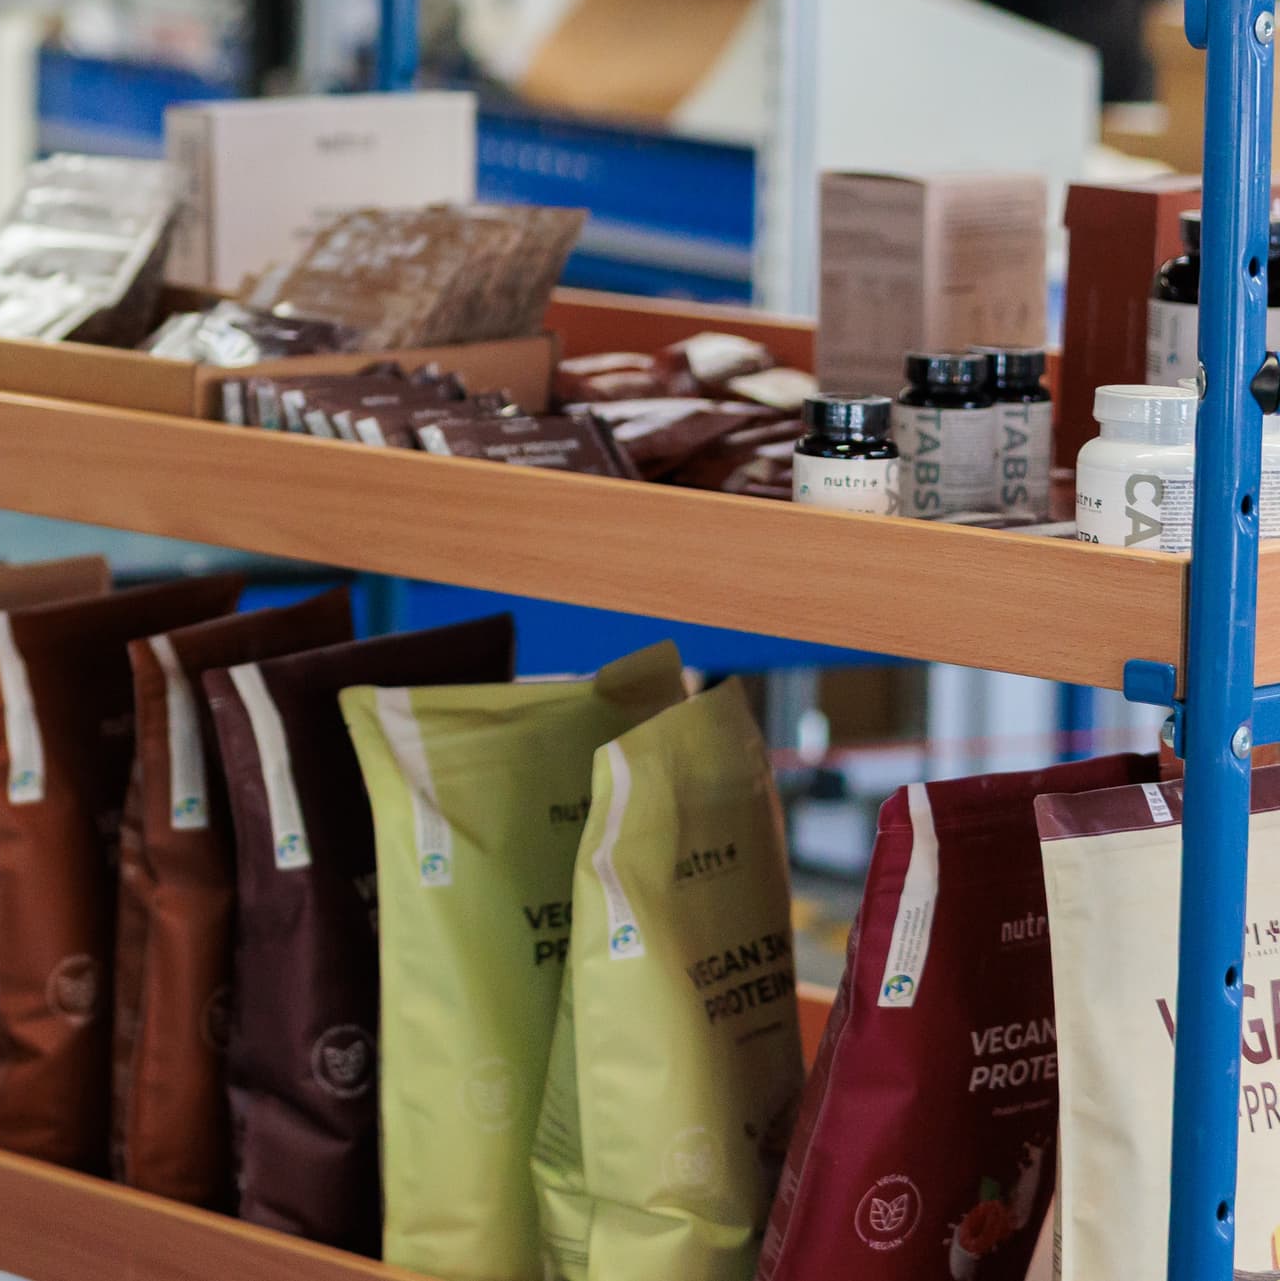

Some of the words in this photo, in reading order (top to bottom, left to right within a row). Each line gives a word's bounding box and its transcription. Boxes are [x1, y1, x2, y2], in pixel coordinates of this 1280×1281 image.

[913, 408, 942, 512] TABS
[1000, 402, 1029, 507] TABS
[823, 476, 878, 489] nutri+
[1001, 911, 1049, 943] nutr
[970, 1018, 1057, 1057] VEGAN
[968, 1052, 1057, 1093] PROTE
